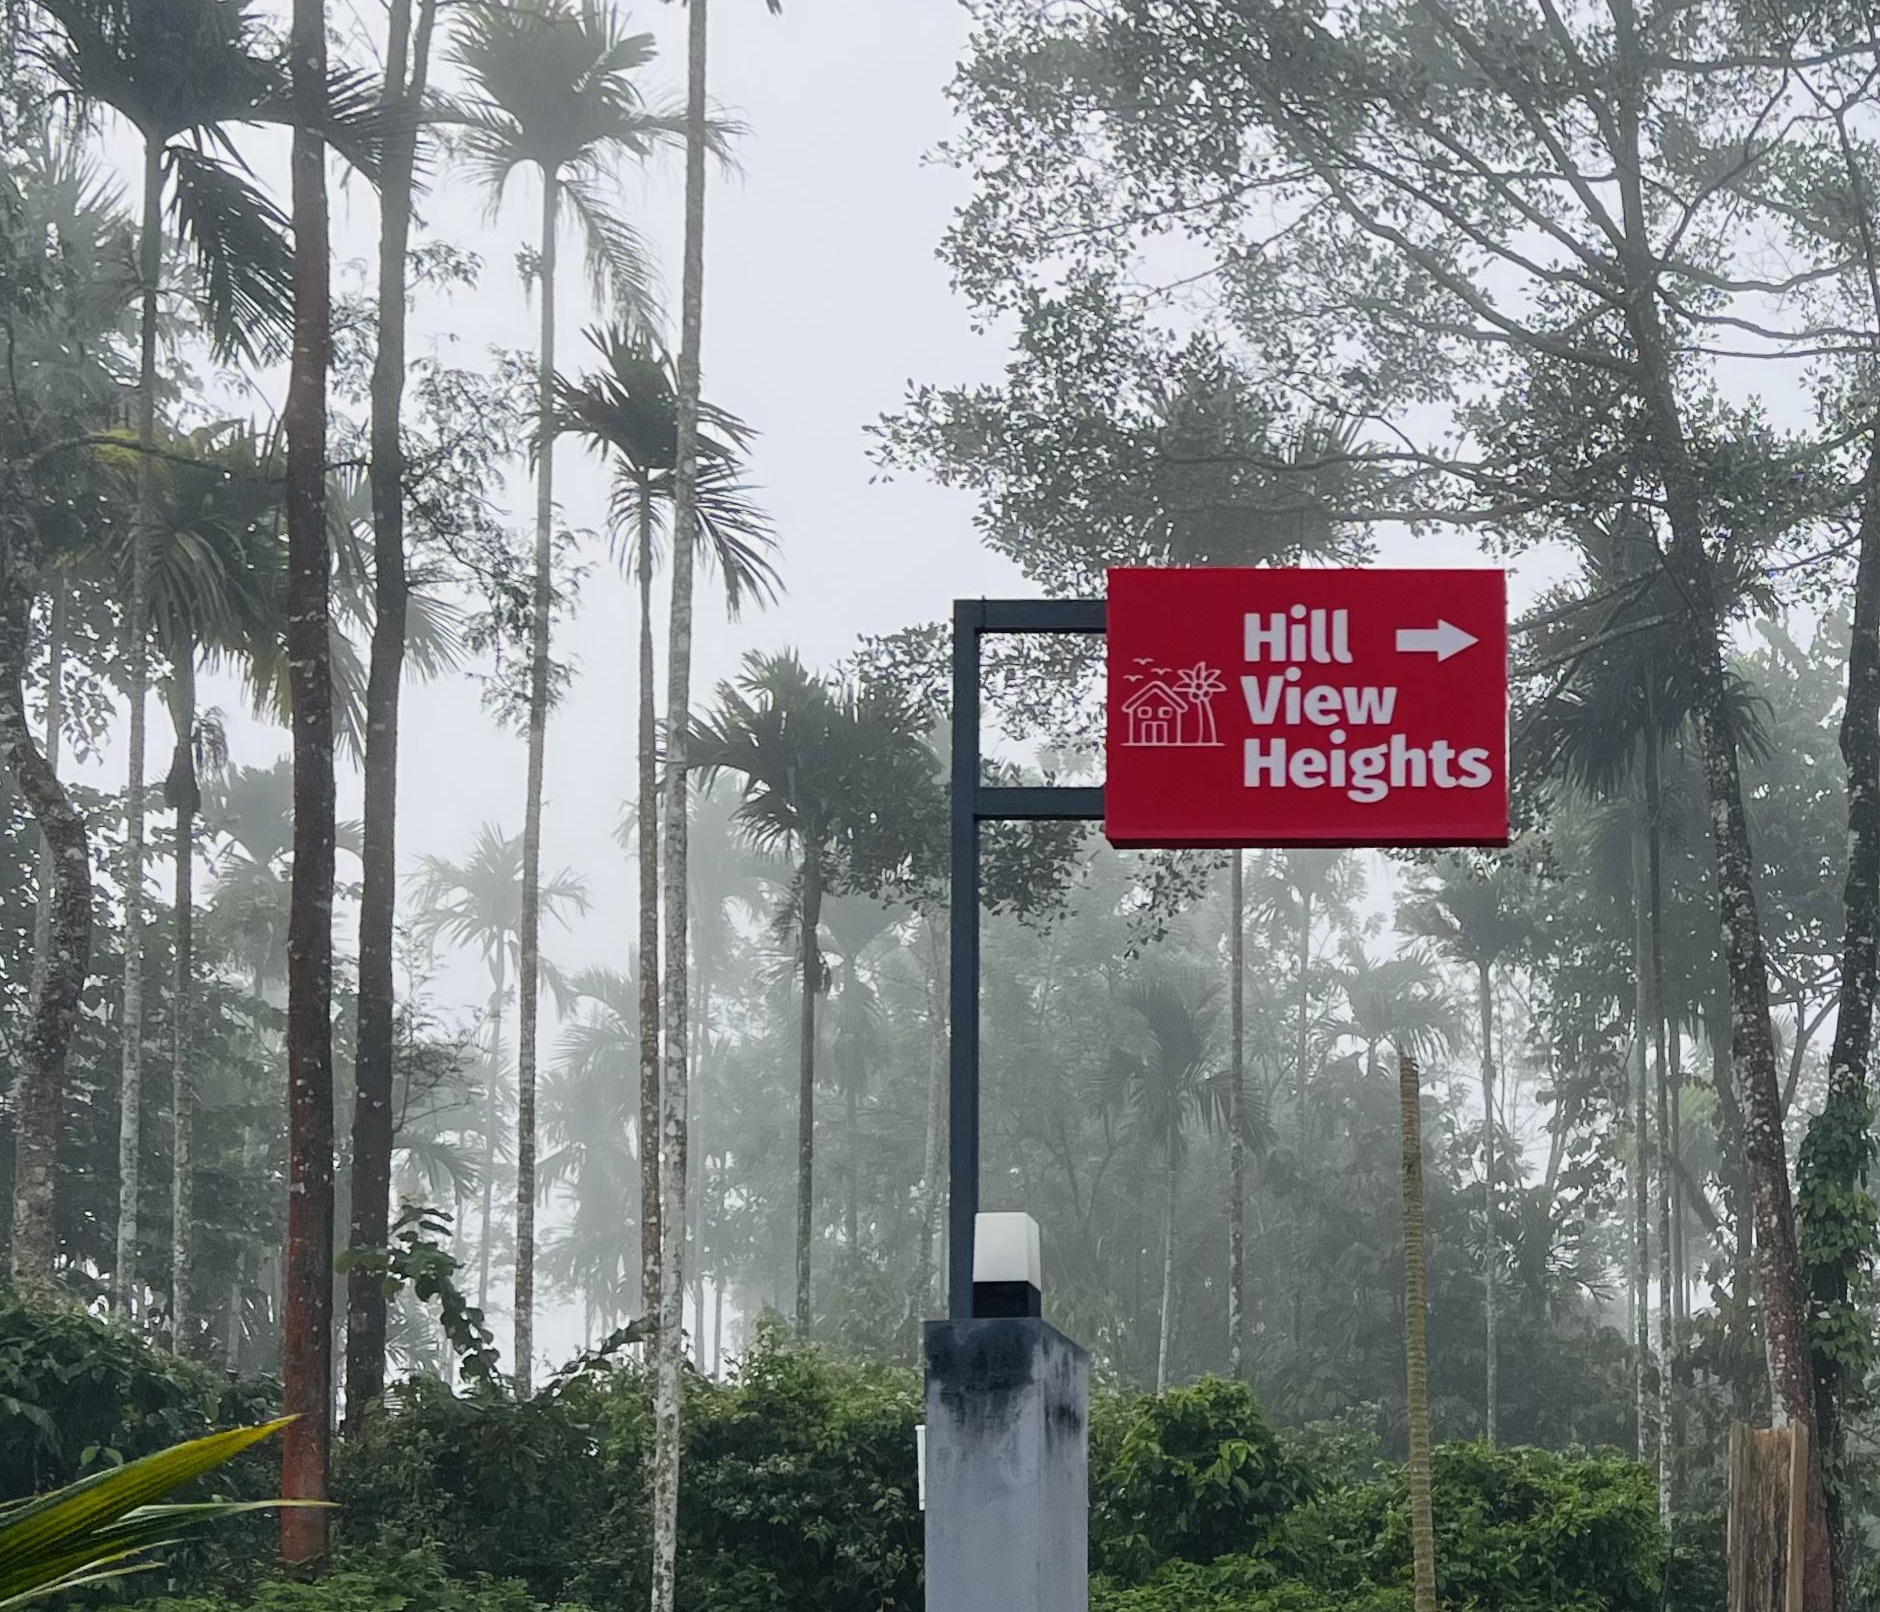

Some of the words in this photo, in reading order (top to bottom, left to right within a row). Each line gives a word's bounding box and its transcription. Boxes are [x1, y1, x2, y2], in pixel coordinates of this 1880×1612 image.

[1244, 604, 1353, 663] Hill
[1240, 666, 1397, 725] View
[1244, 729, 1492, 803] Heights
